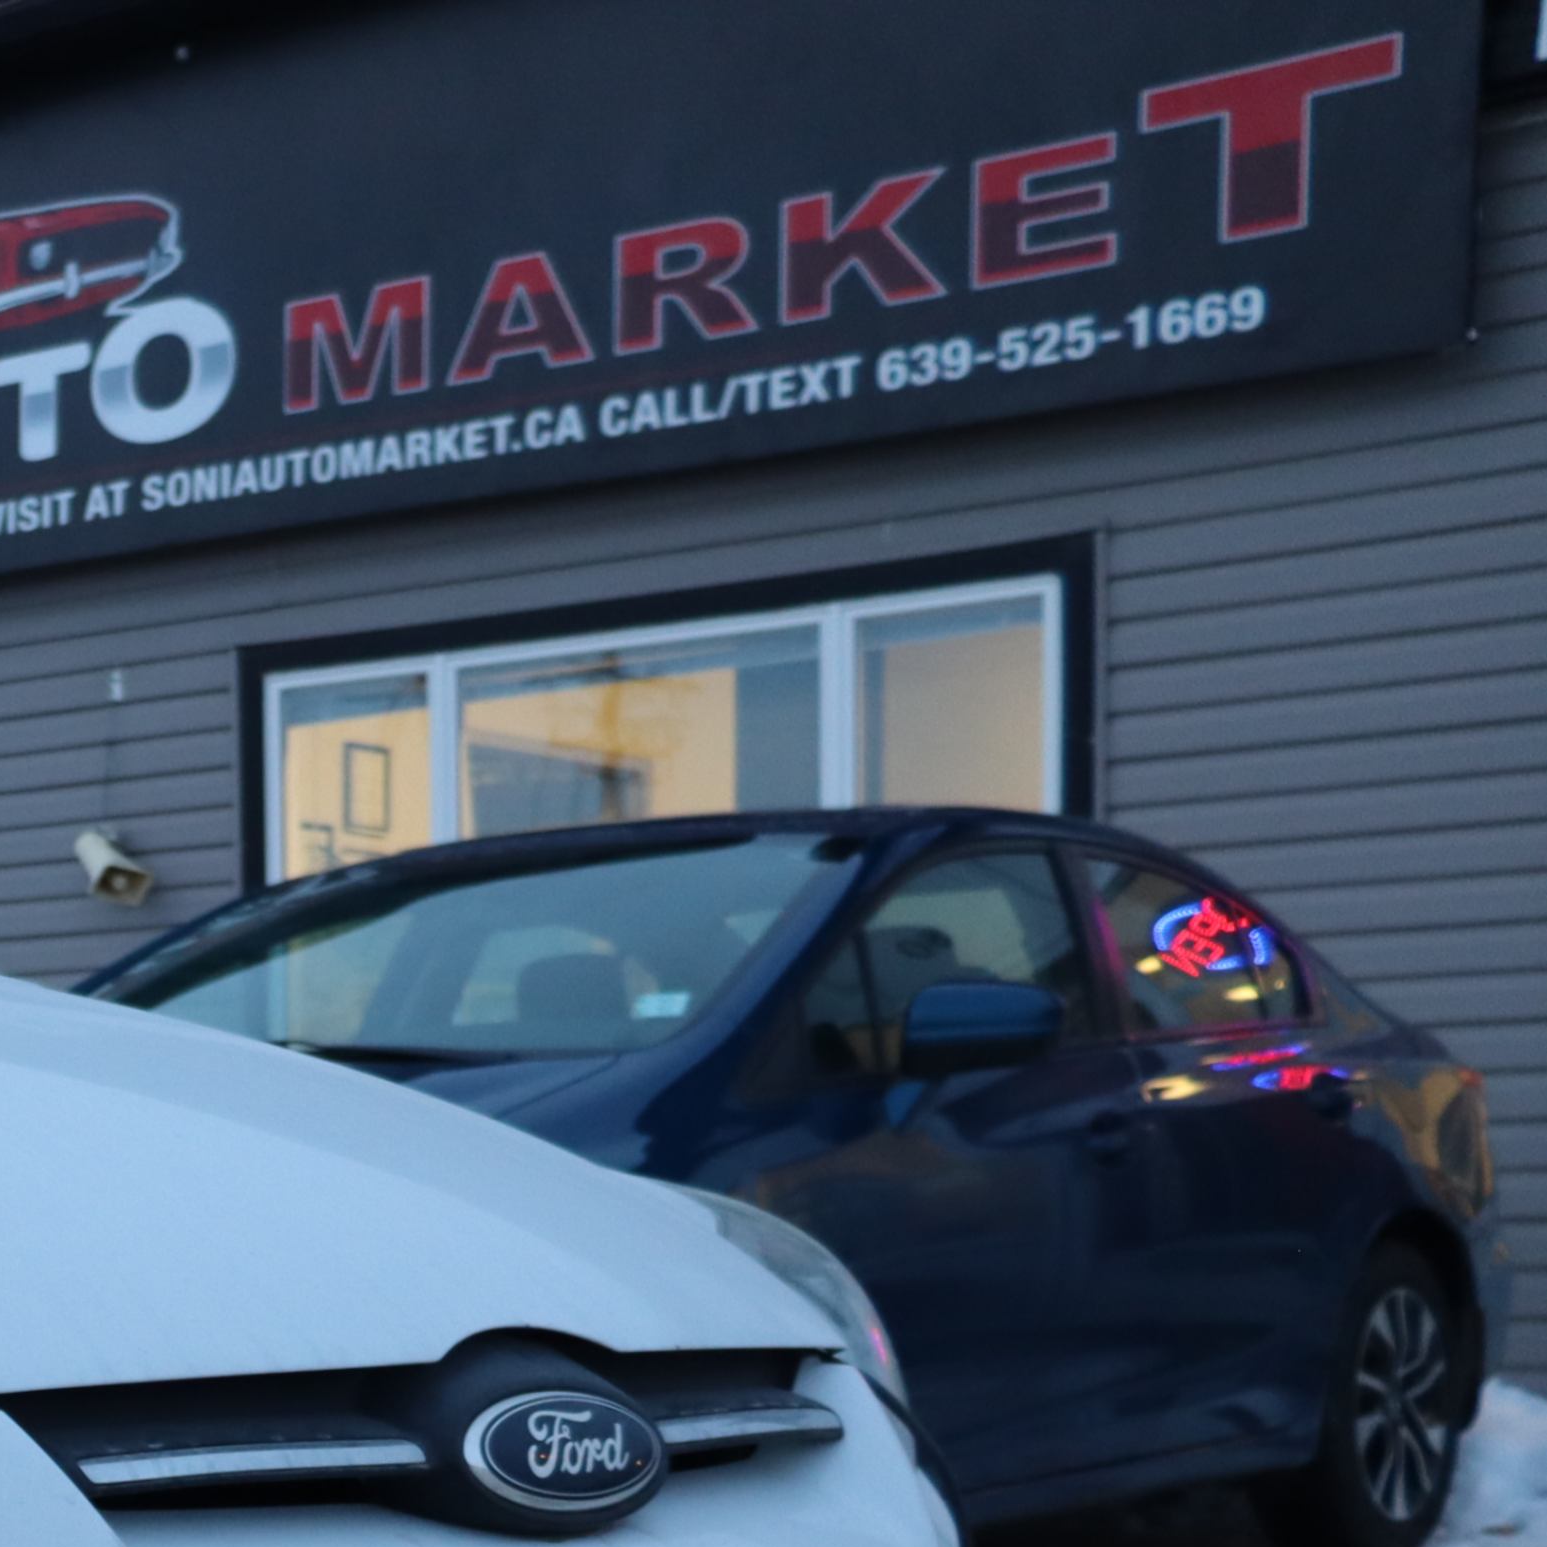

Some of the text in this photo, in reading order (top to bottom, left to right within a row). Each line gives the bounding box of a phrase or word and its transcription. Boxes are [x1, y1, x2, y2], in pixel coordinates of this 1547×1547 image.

[283, 32, 1405, 416] MARKET
[84, 480, 133, 523] AT
[140, 403, 587, 512] SONIAUTOMARKET.CA
[598, 354, 864, 440] CALL/TEXT
[875, 285, 1267, 393] 639-525-1669
[527, 1409, 630, 1479] Ford
